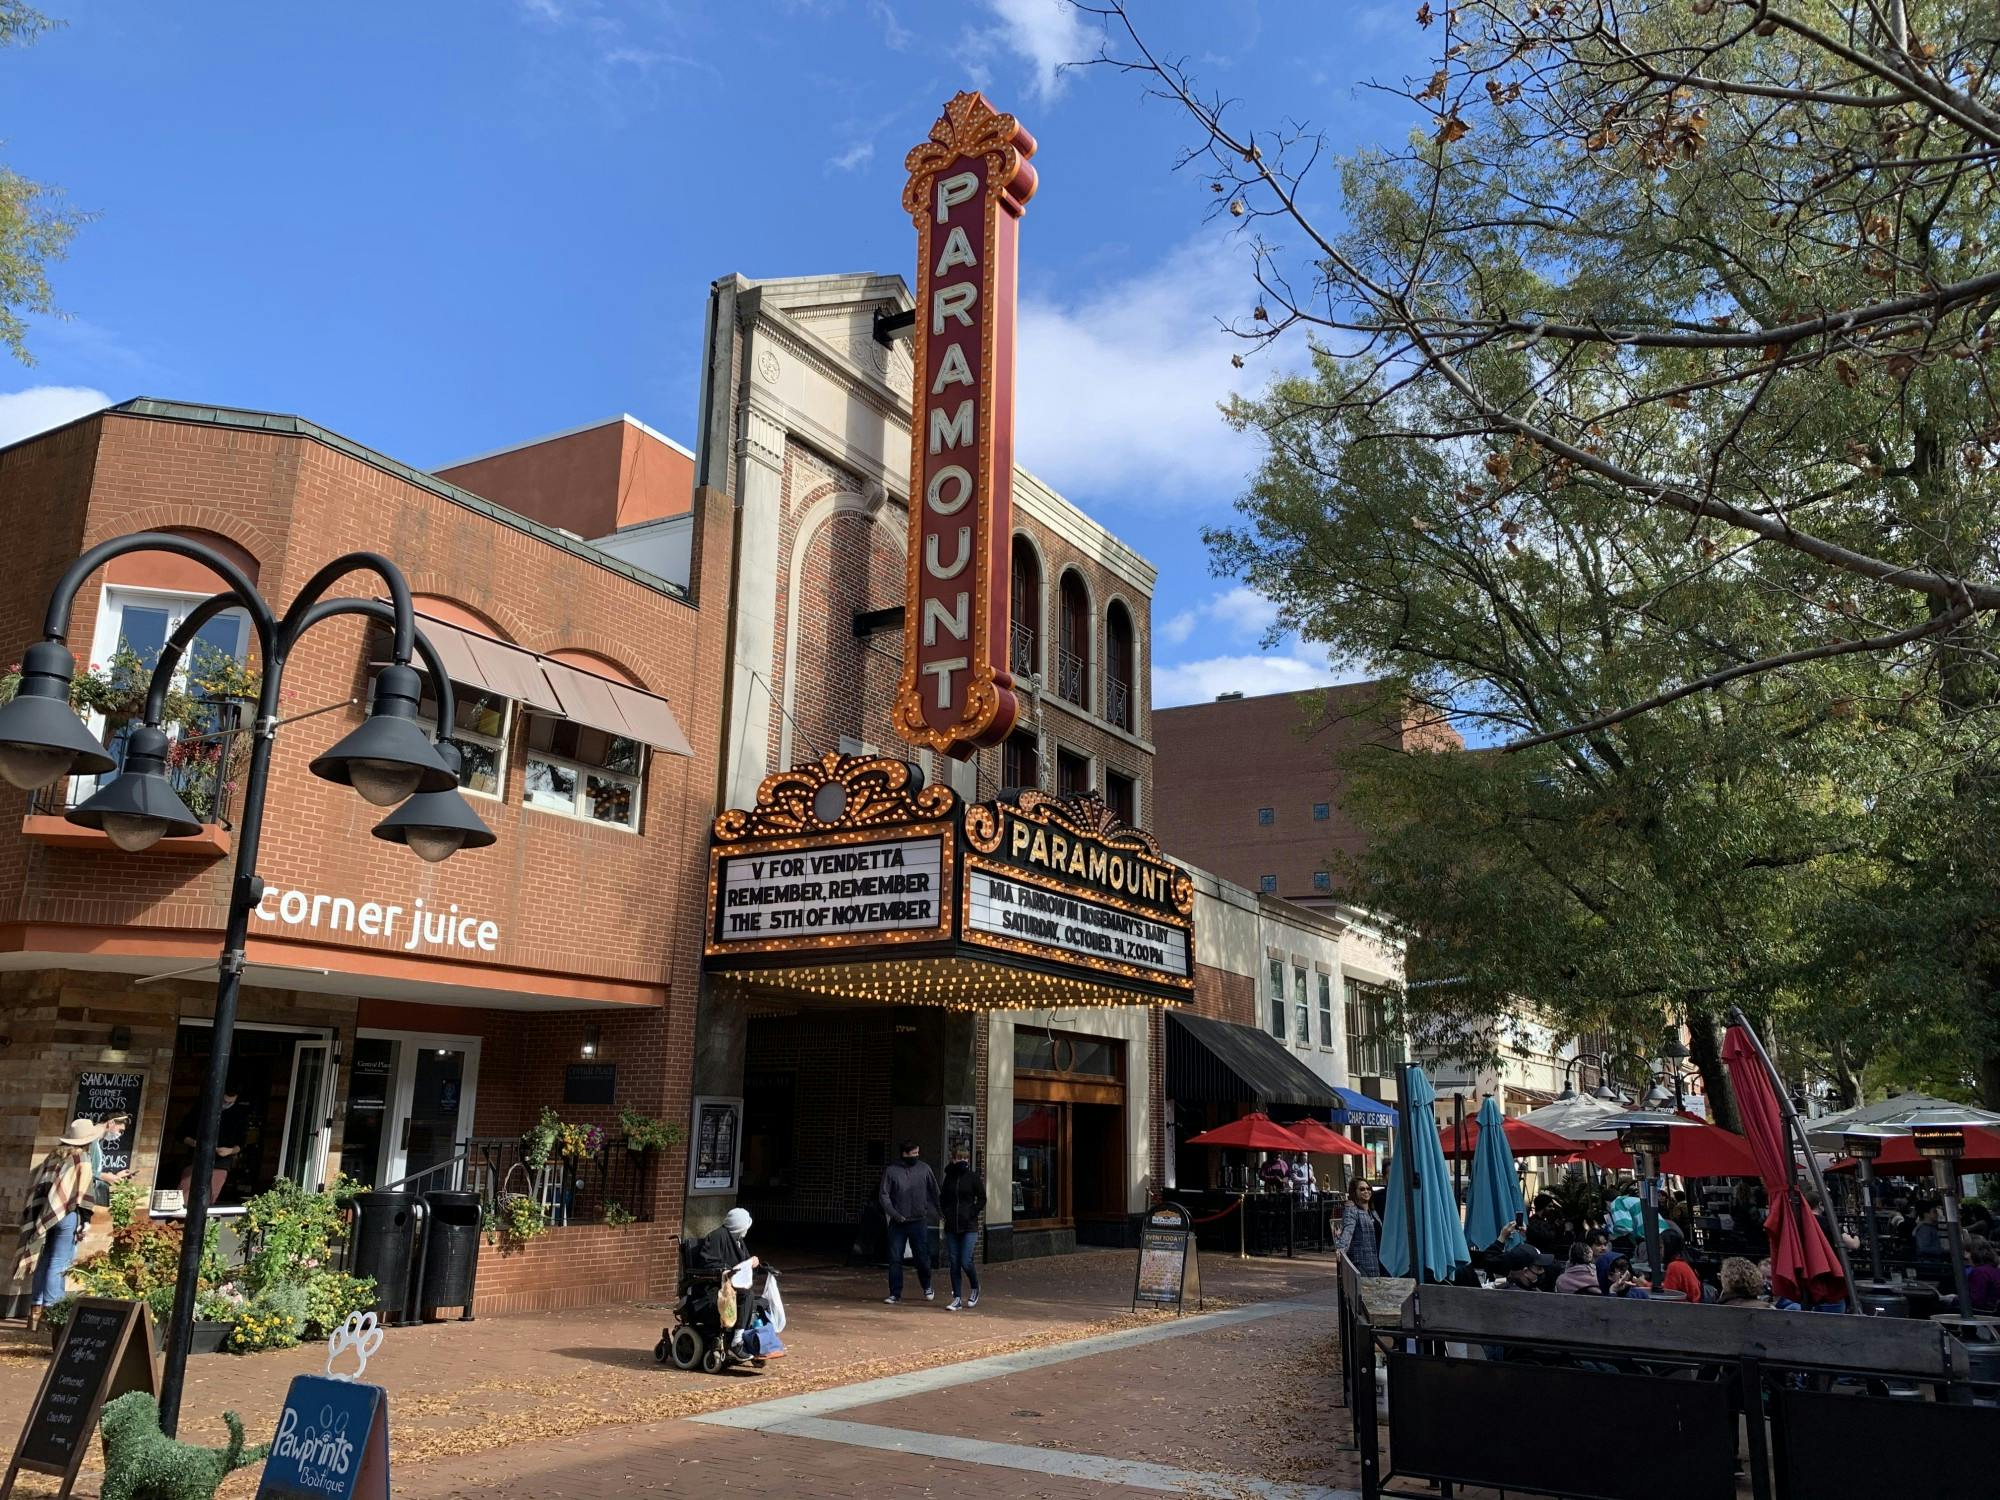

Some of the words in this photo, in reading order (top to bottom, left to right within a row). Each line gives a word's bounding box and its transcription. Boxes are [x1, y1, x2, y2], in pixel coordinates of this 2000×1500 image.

[922, 171, 979, 709] PARAMOUNT
[752, 862, 764, 880] V
[769, 859, 804, 878] FOR
[811, 848, 904, 874] VENDETTA
[1012, 820, 1168, 903] PARAMOUNT
[728, 882, 827, 907] REMEMBER,
[829, 873, 930, 900] REMEMBER
[255, 887, 403, 937] corner
[404, 898, 499, 951] juice
[730, 912, 761, 932] THE
[769, 910, 802, 930] 5TH
[806, 907, 830, 926] OF
[832, 900, 931, 925] NOVEMBER
[990, 880, 1014, 903] MIA
[1018, 887, 1067, 917] FARROW
[1067, 901, 1079, 920] IN
[1145, 923, 1169, 944] BABY
[1065, 925, 1113, 953] OCTOBER
[81, 1072, 140, 1087] SANDWICHES
[89, 1088, 122, 1097] GOURMET
[88, 1096, 127, 1110] TOASTS
[1367, 1113, 1376, 1125] ICE
[1376, 1113, 1393, 1126] CREAM
[272, 1407, 353, 1475] Pawprints
[300, 1466, 345, 1495] Boutique
